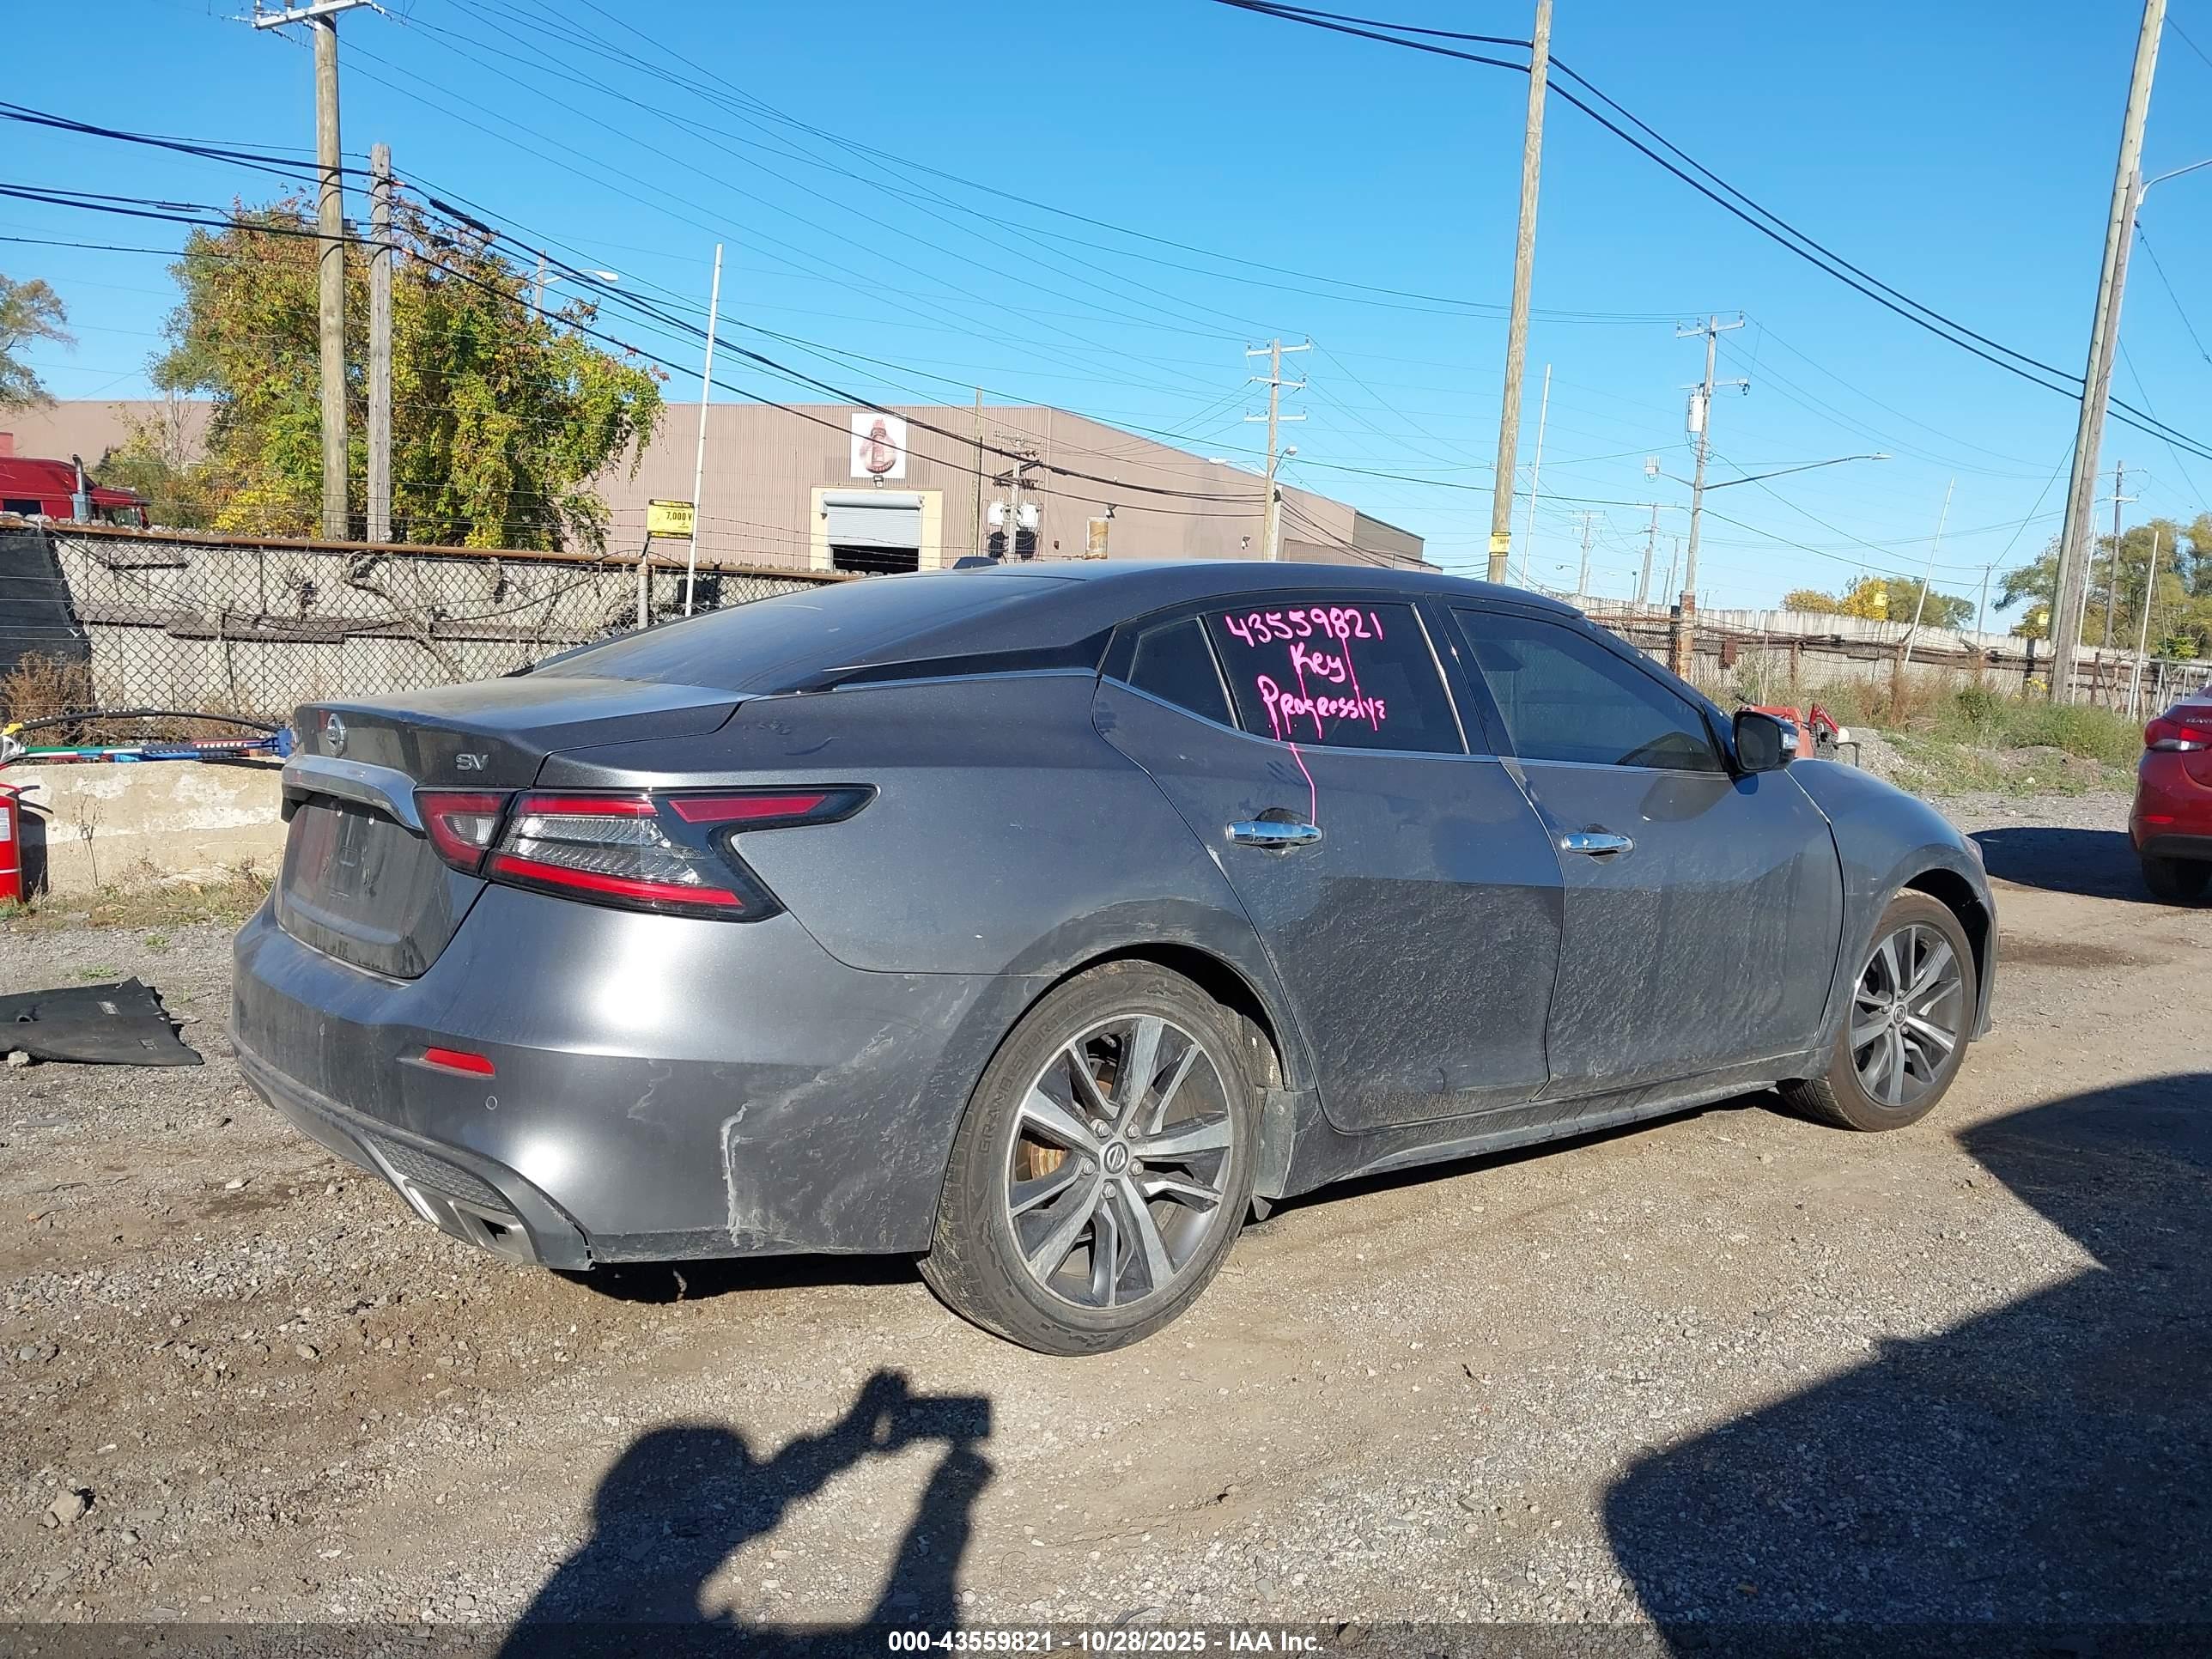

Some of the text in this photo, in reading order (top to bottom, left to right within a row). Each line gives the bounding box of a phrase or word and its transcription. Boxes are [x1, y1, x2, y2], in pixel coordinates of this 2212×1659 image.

[665, 511, 693, 521] 7,000 V
[1225, 607, 1384, 647] 43559821
[1290, 641, 1346, 684] Key
[455, 753, 489, 771] SV
